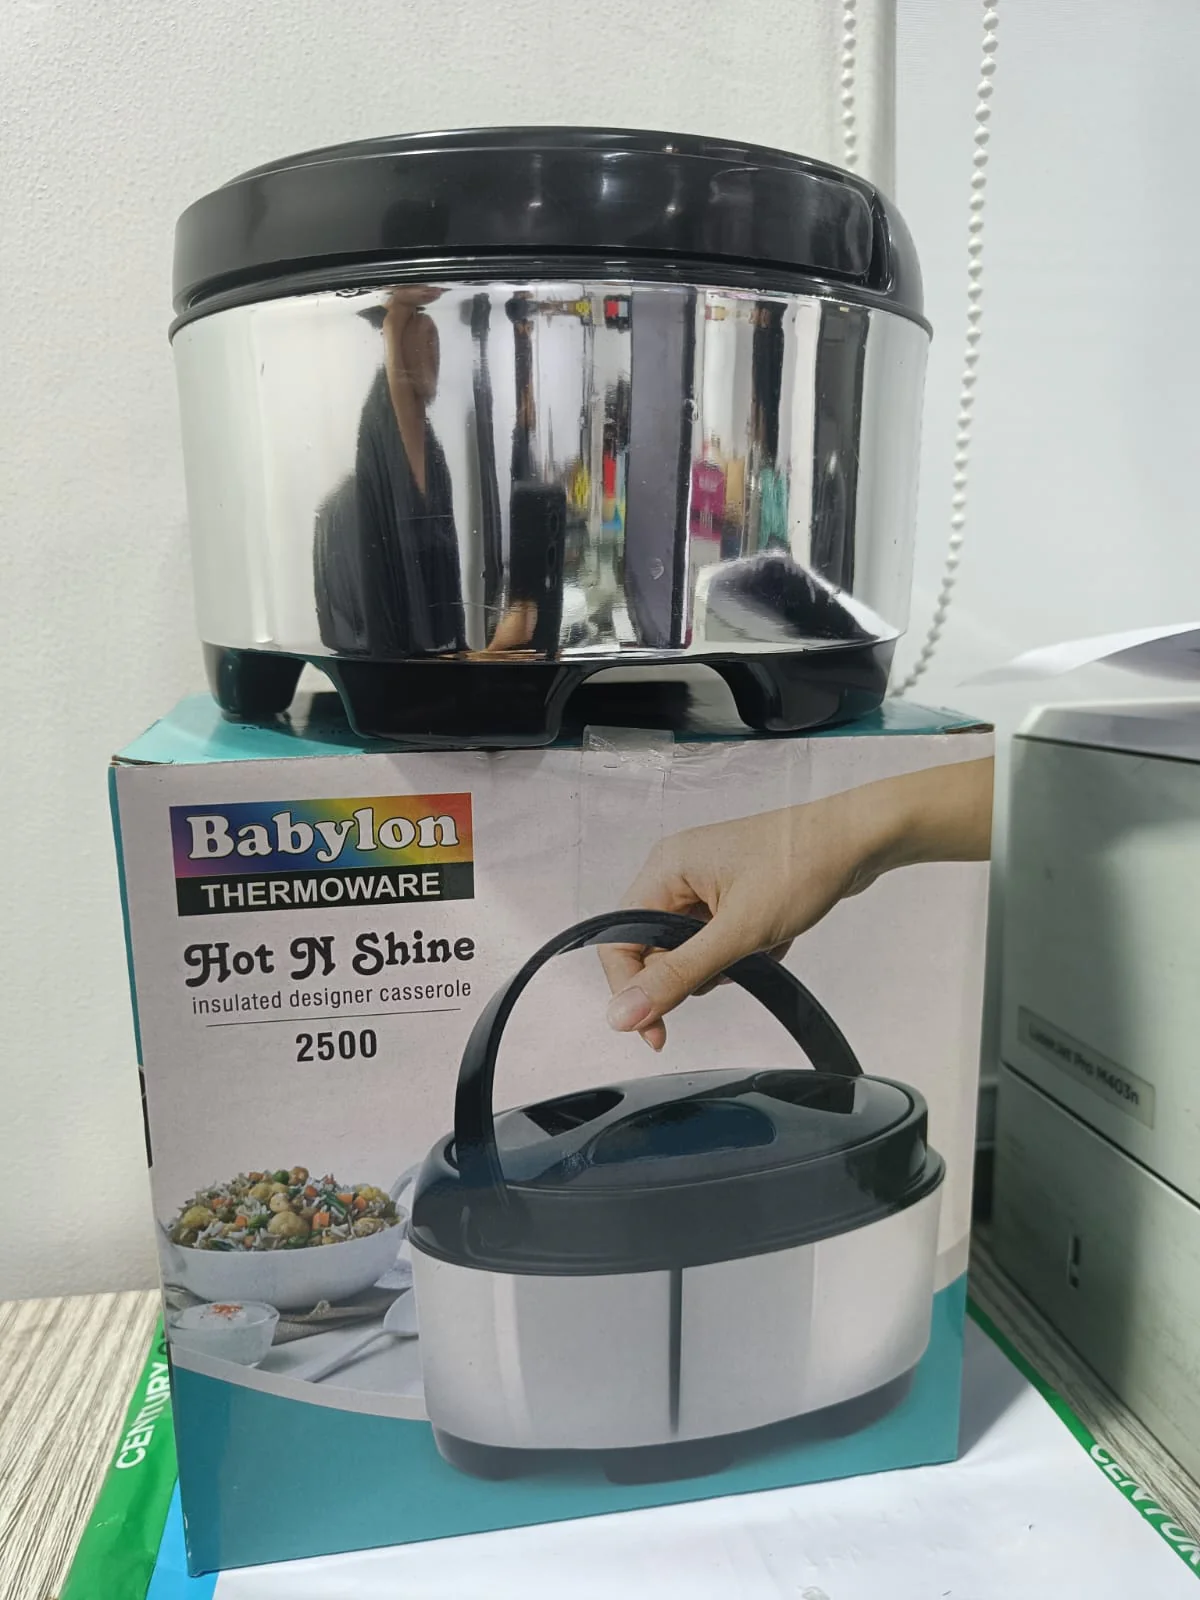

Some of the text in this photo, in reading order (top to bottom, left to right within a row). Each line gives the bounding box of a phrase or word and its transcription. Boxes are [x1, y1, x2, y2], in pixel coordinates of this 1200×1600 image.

[186, 806, 460, 864] Babylon
[200, 872, 441, 908] THERMOWARE
[183, 930, 475, 988] Hot N Shine
[192, 979, 471, 1015] insulated designer casserole
[295, 1029, 378, 1062] 2500
[115, 1361, 171, 1469] CENTURY
